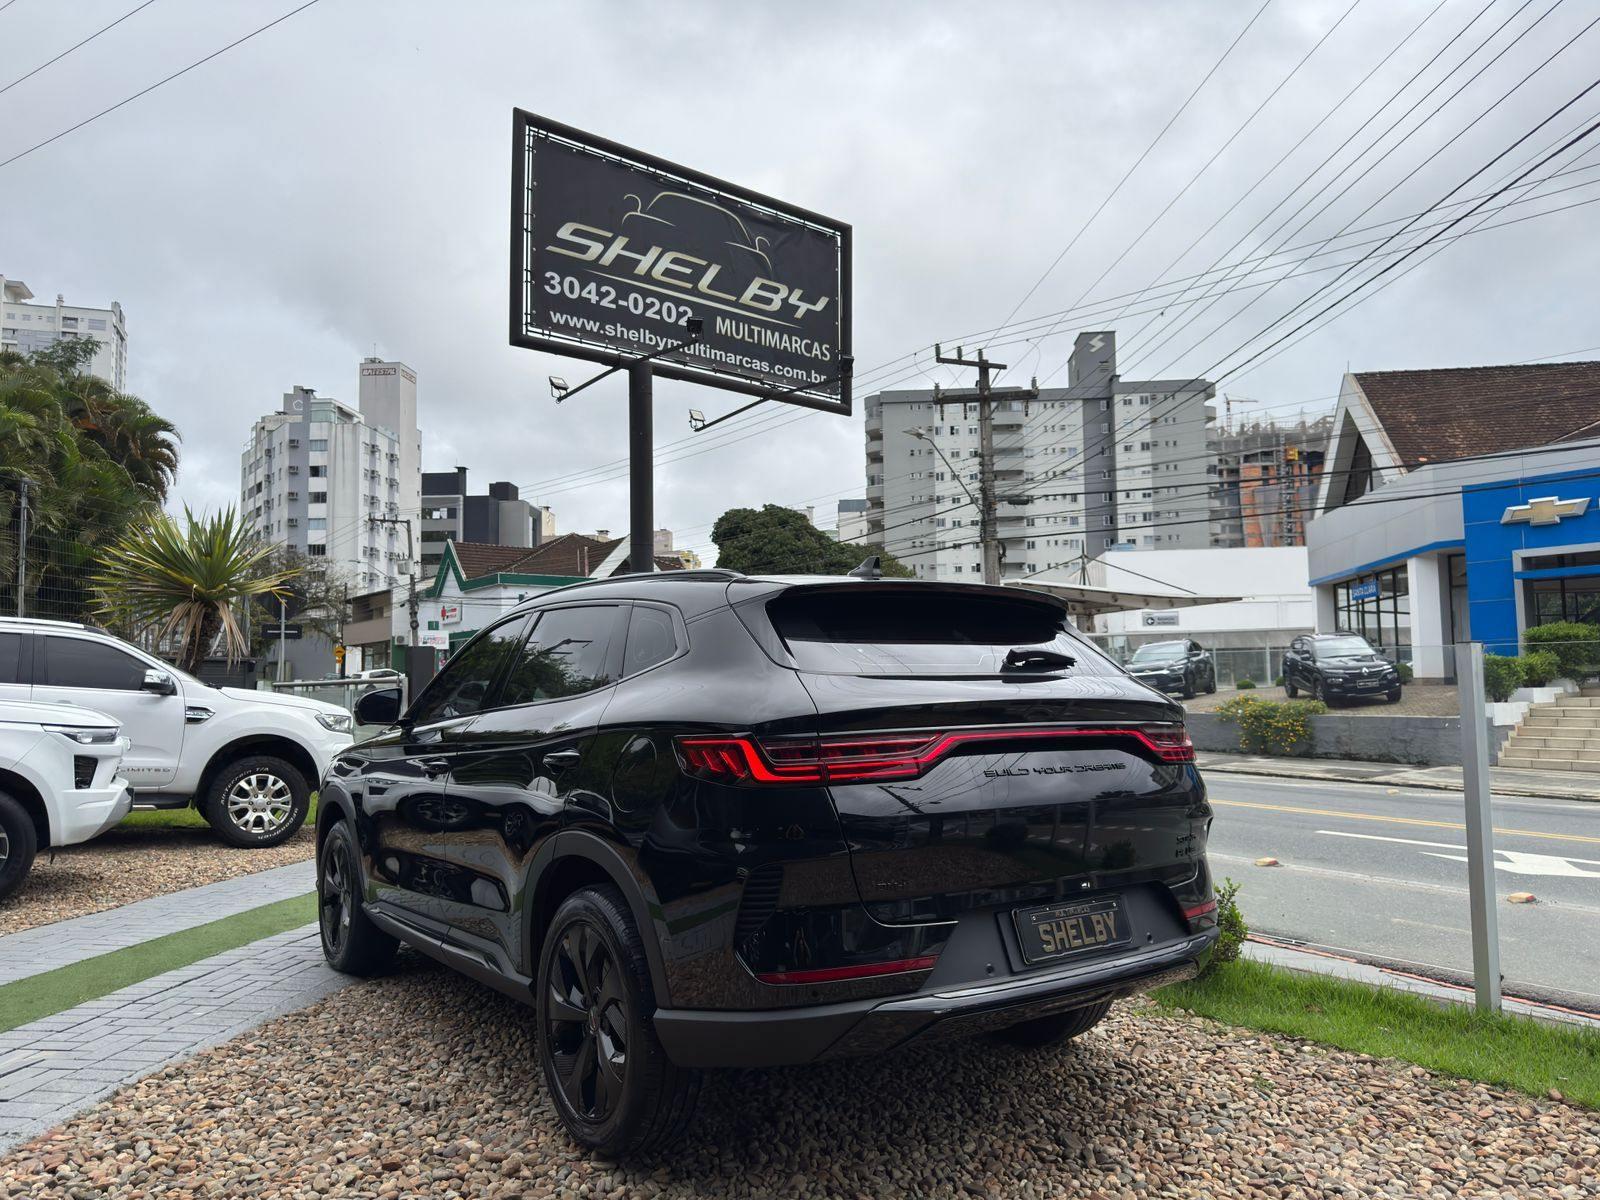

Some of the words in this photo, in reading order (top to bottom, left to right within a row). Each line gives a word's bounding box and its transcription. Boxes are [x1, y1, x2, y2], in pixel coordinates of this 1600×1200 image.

[545, 222, 830, 319] SHELBY
[544, 271, 693, 327] 3042-0202
[550, 310, 827, 384] www.shelbymultimarcas.com.br
[716, 316, 831, 361] MULTIMARCAS
[984, 769, 1029, 777] BUILD
[1033, 766, 1073, 775] YOUR
[1074, 762, 1126, 772] DREAMS
[1038, 911, 1117, 953] SHELBY
